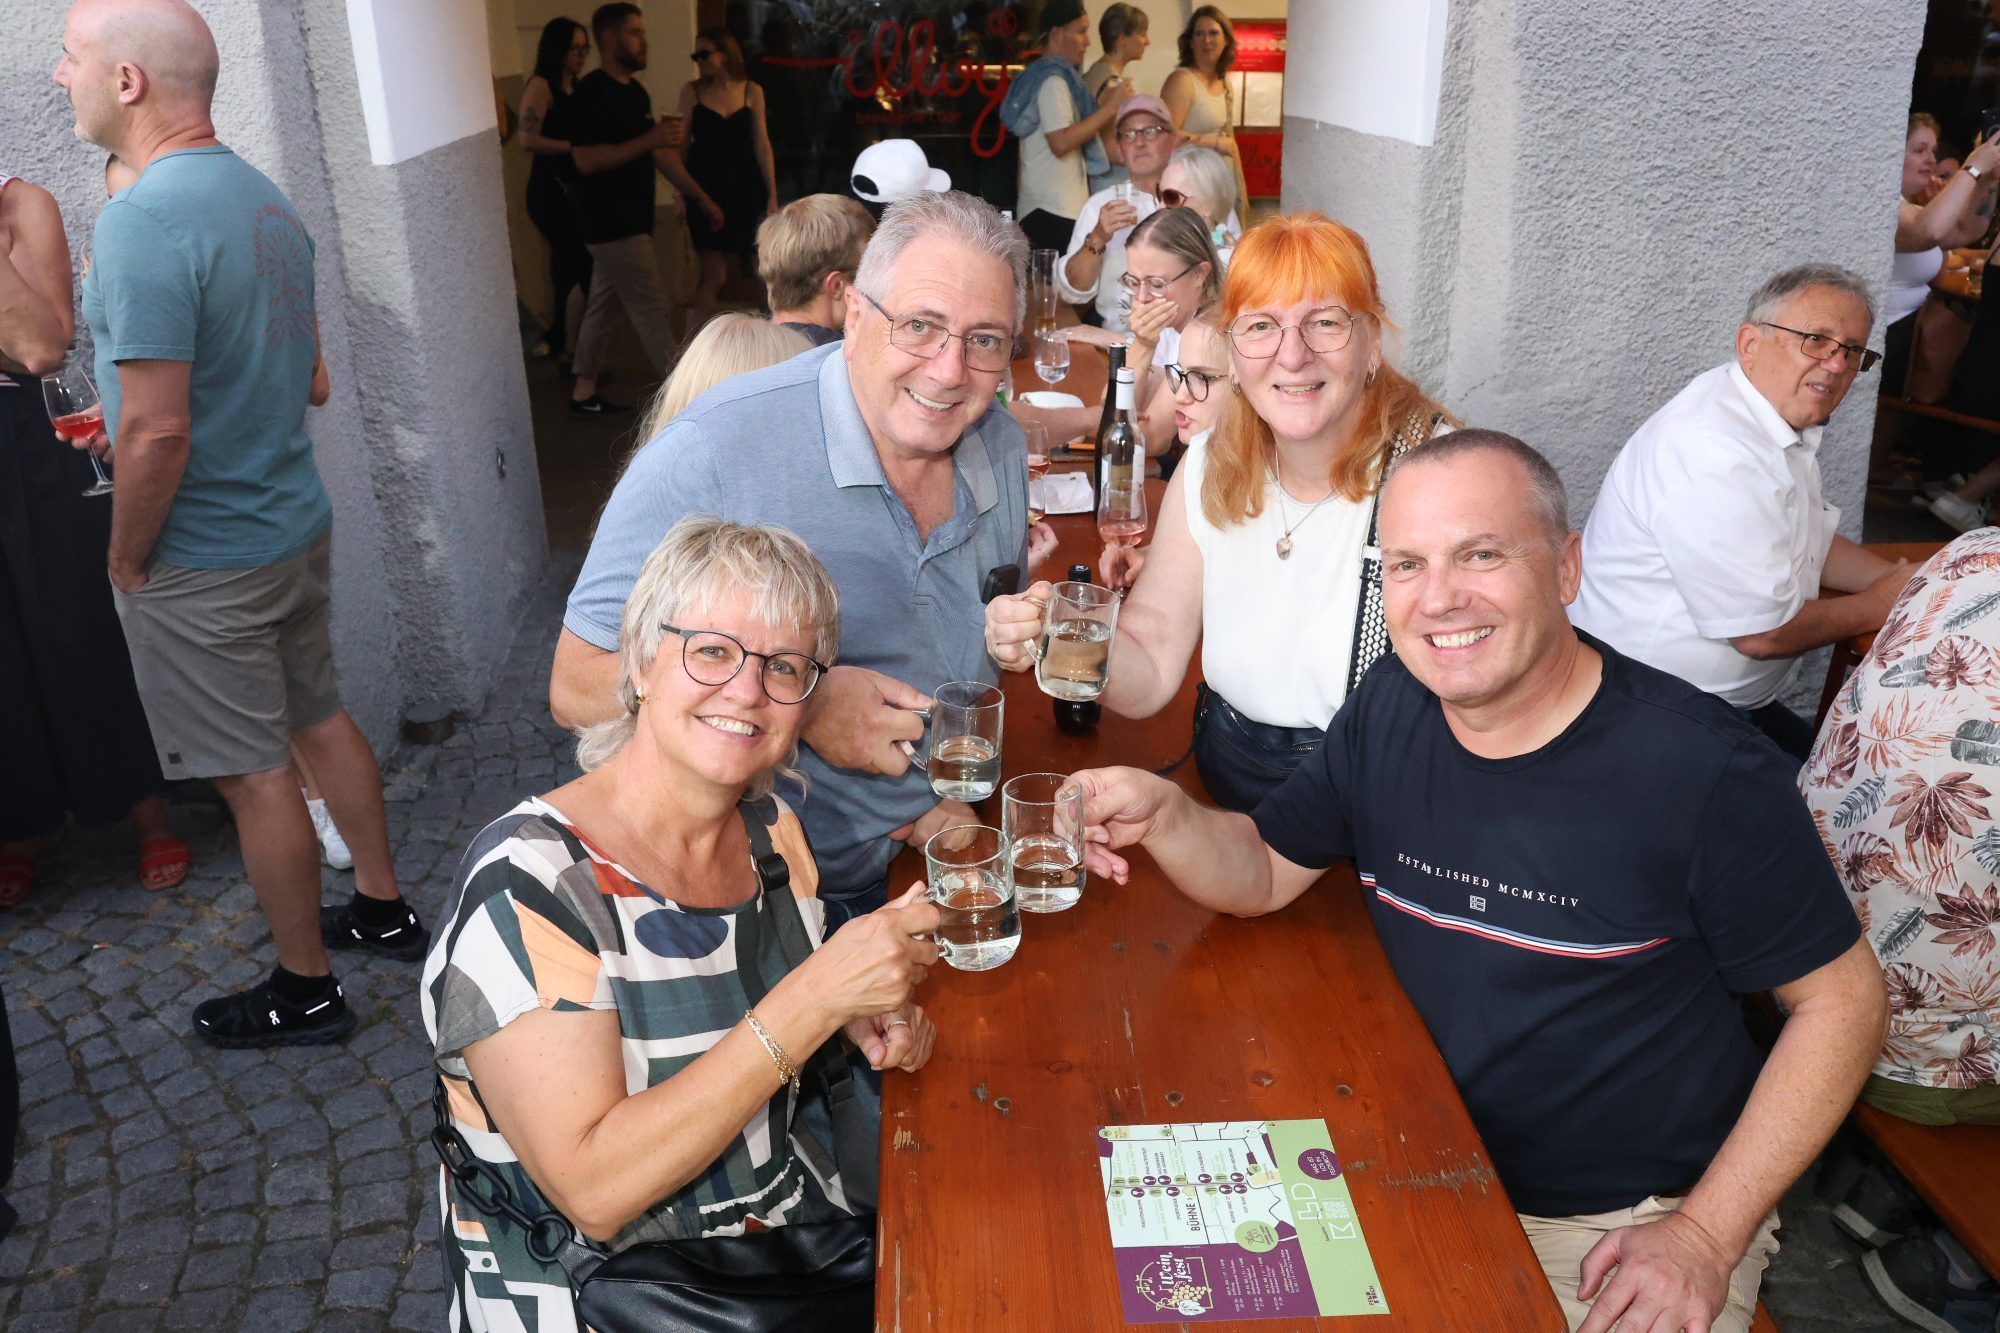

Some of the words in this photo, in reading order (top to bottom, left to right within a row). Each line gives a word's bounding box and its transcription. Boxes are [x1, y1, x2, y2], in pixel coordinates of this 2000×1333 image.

[1397, 852, 1490, 888] ESTABLISHED
[1498, 882, 1580, 907] MCMXCIV
[1311, 1163, 1320, 1174] WAS
[1186, 1202, 1200, 1231] BÜHNE
